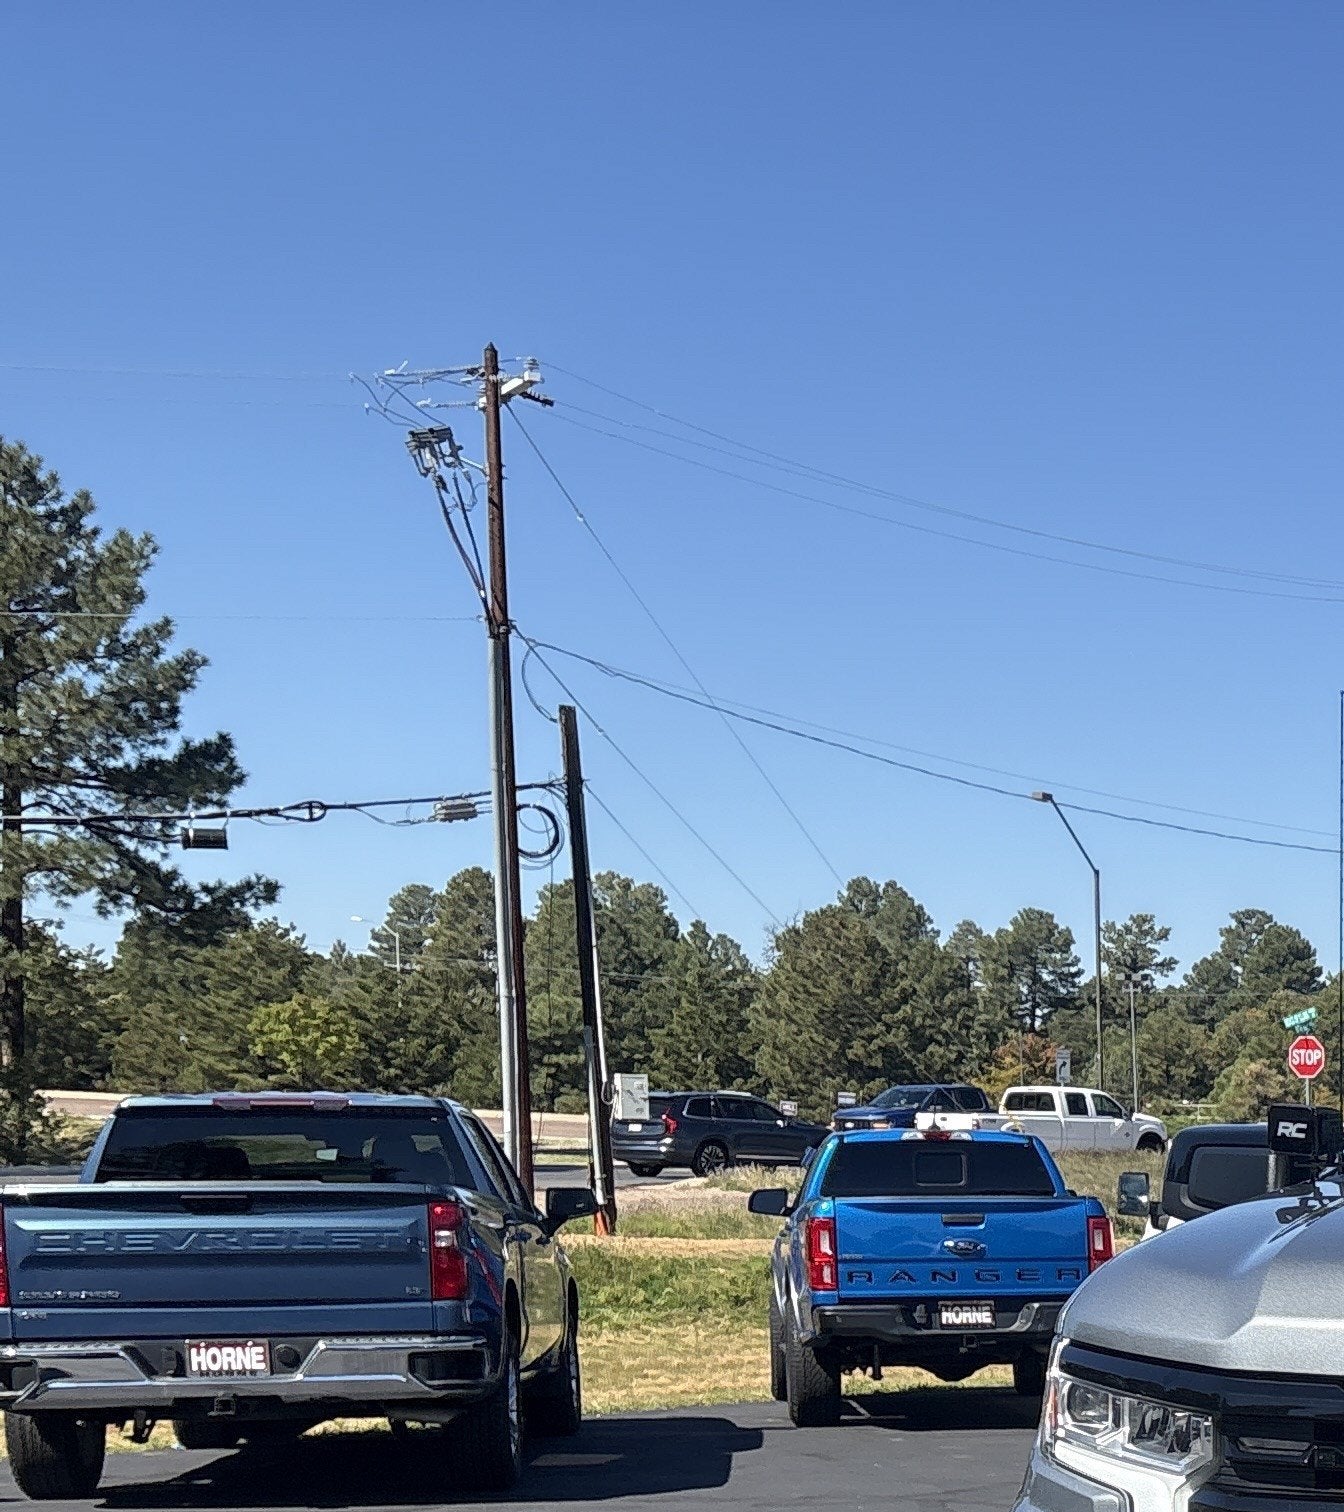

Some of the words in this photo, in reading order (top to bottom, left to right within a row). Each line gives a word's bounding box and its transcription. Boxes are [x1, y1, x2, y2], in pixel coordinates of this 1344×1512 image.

[1292, 1048, 1321, 1066] STOP
[1277, 1121, 1308, 1139] RC
[33, 1229, 402, 1252] CHEVROLET
[846, 1267, 1083, 1285] RANGER
[941, 1304, 993, 1325] HORNE
[190, 1346, 266, 1371] HORNE
